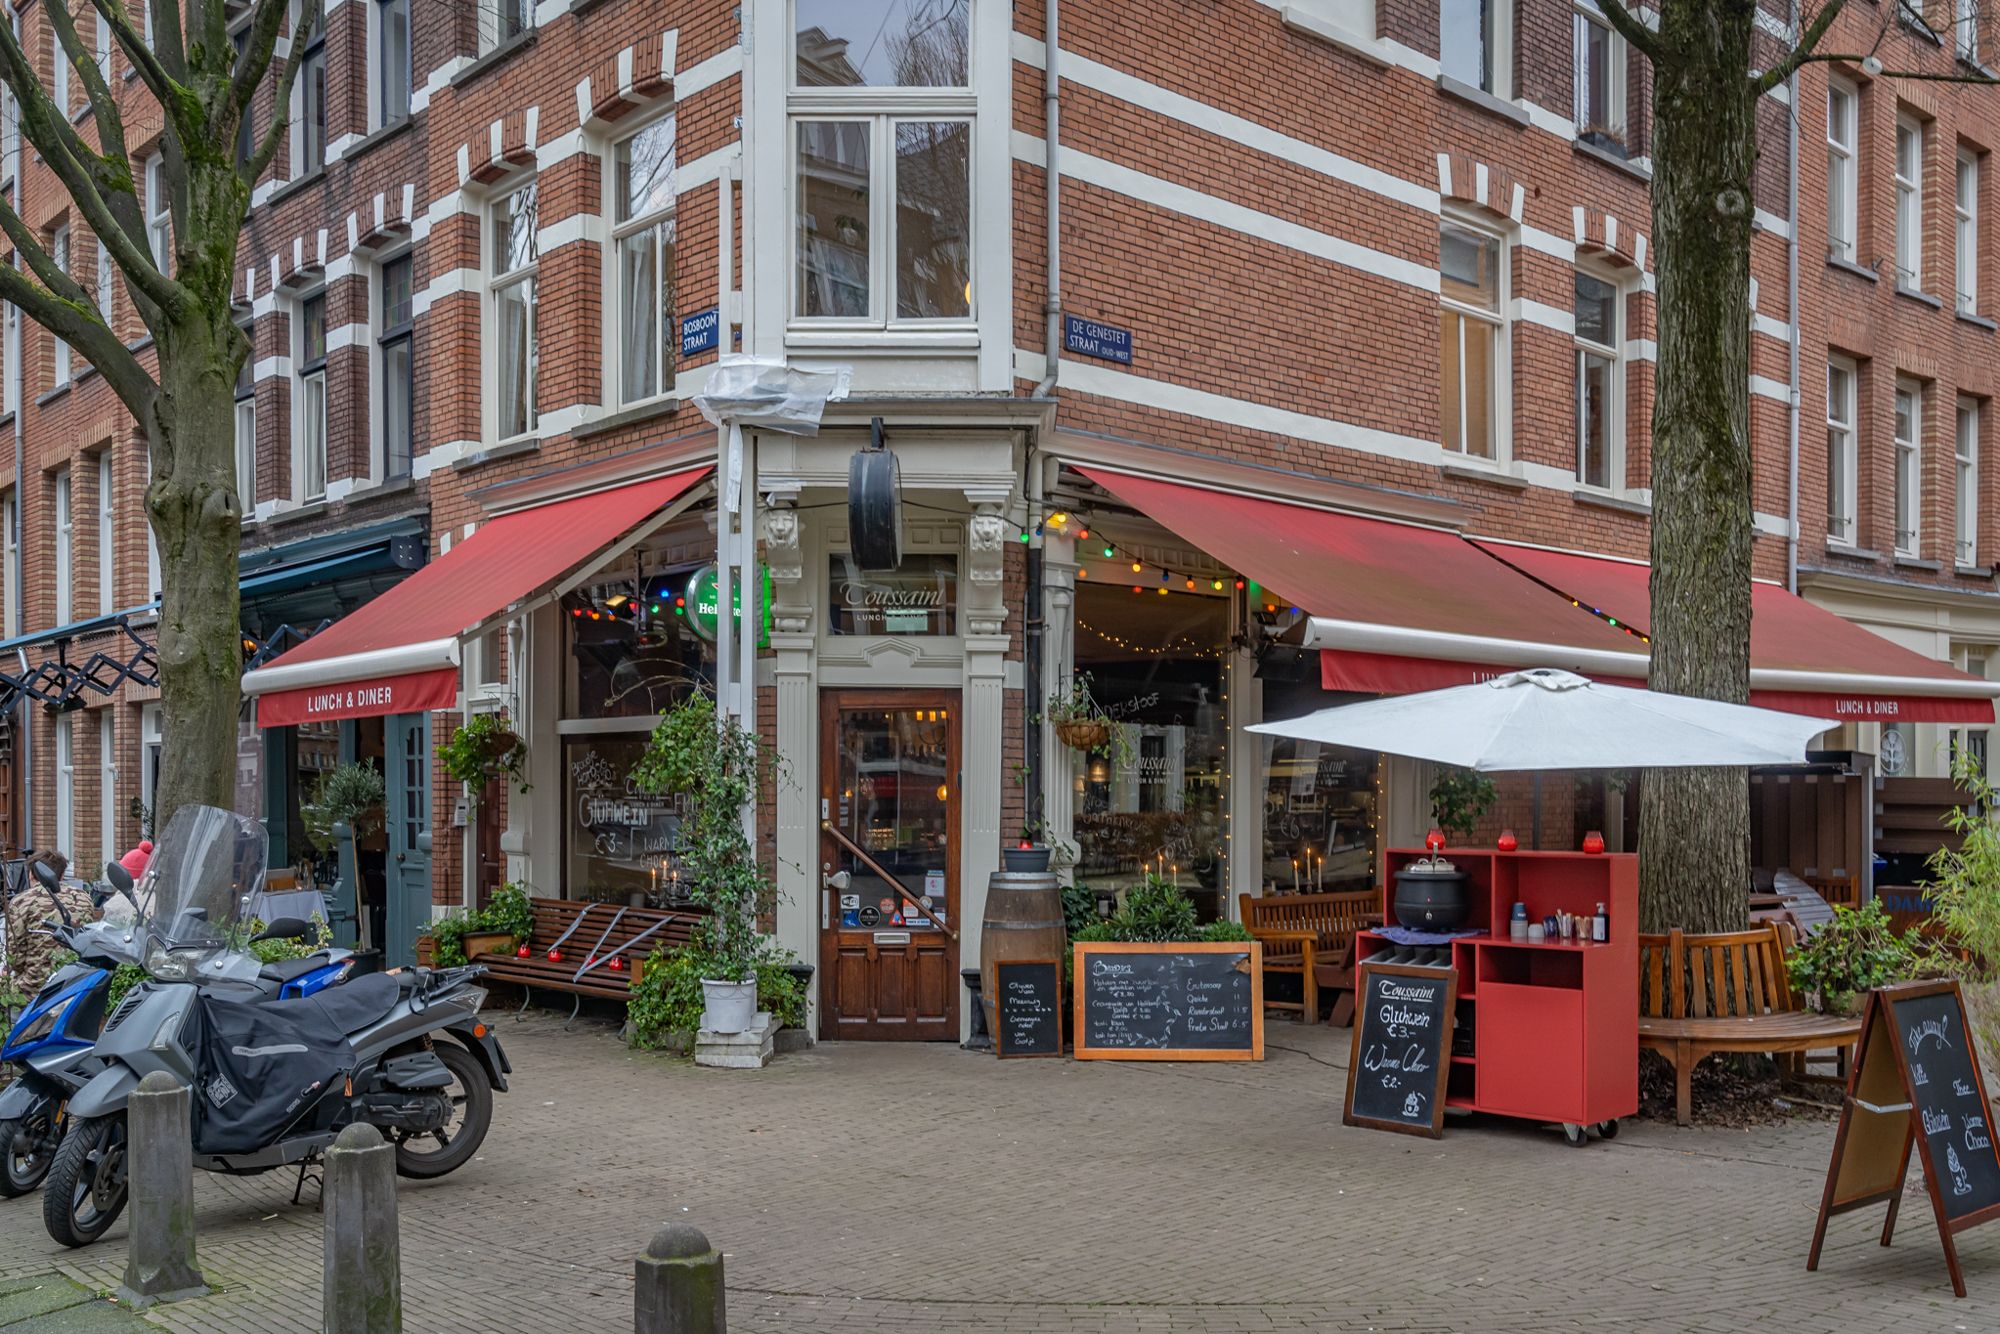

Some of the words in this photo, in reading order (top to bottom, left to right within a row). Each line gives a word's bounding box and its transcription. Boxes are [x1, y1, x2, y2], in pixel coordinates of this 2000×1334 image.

[683, 313, 717, 336] BOSBOOM
[1072, 320, 1084, 335] DE
[1086, 324, 1126, 345] GENESTET
[683, 332, 707, 351] STRAAT
[1070, 335, 1099, 353] STRAAT
[1101, 346, 1129, 360] OUD-WEST
[840, 582, 945, 606] Toussaint
[856, 613, 886, 621] LUNCH
[308, 693, 342, 712] LUNCH
[346, 691, 354, 708] &
[358, 686, 391, 707] DINER
[1836, 700, 1863, 714] LUNCH
[1867, 701, 1872, 714] &
[1874, 701, 1899, 714] DINER
[1233, 978, 1239, 987] 6
[1378, 979, 1434, 999] Toussaint
[1965, 1129, 1989, 1150] Choco
